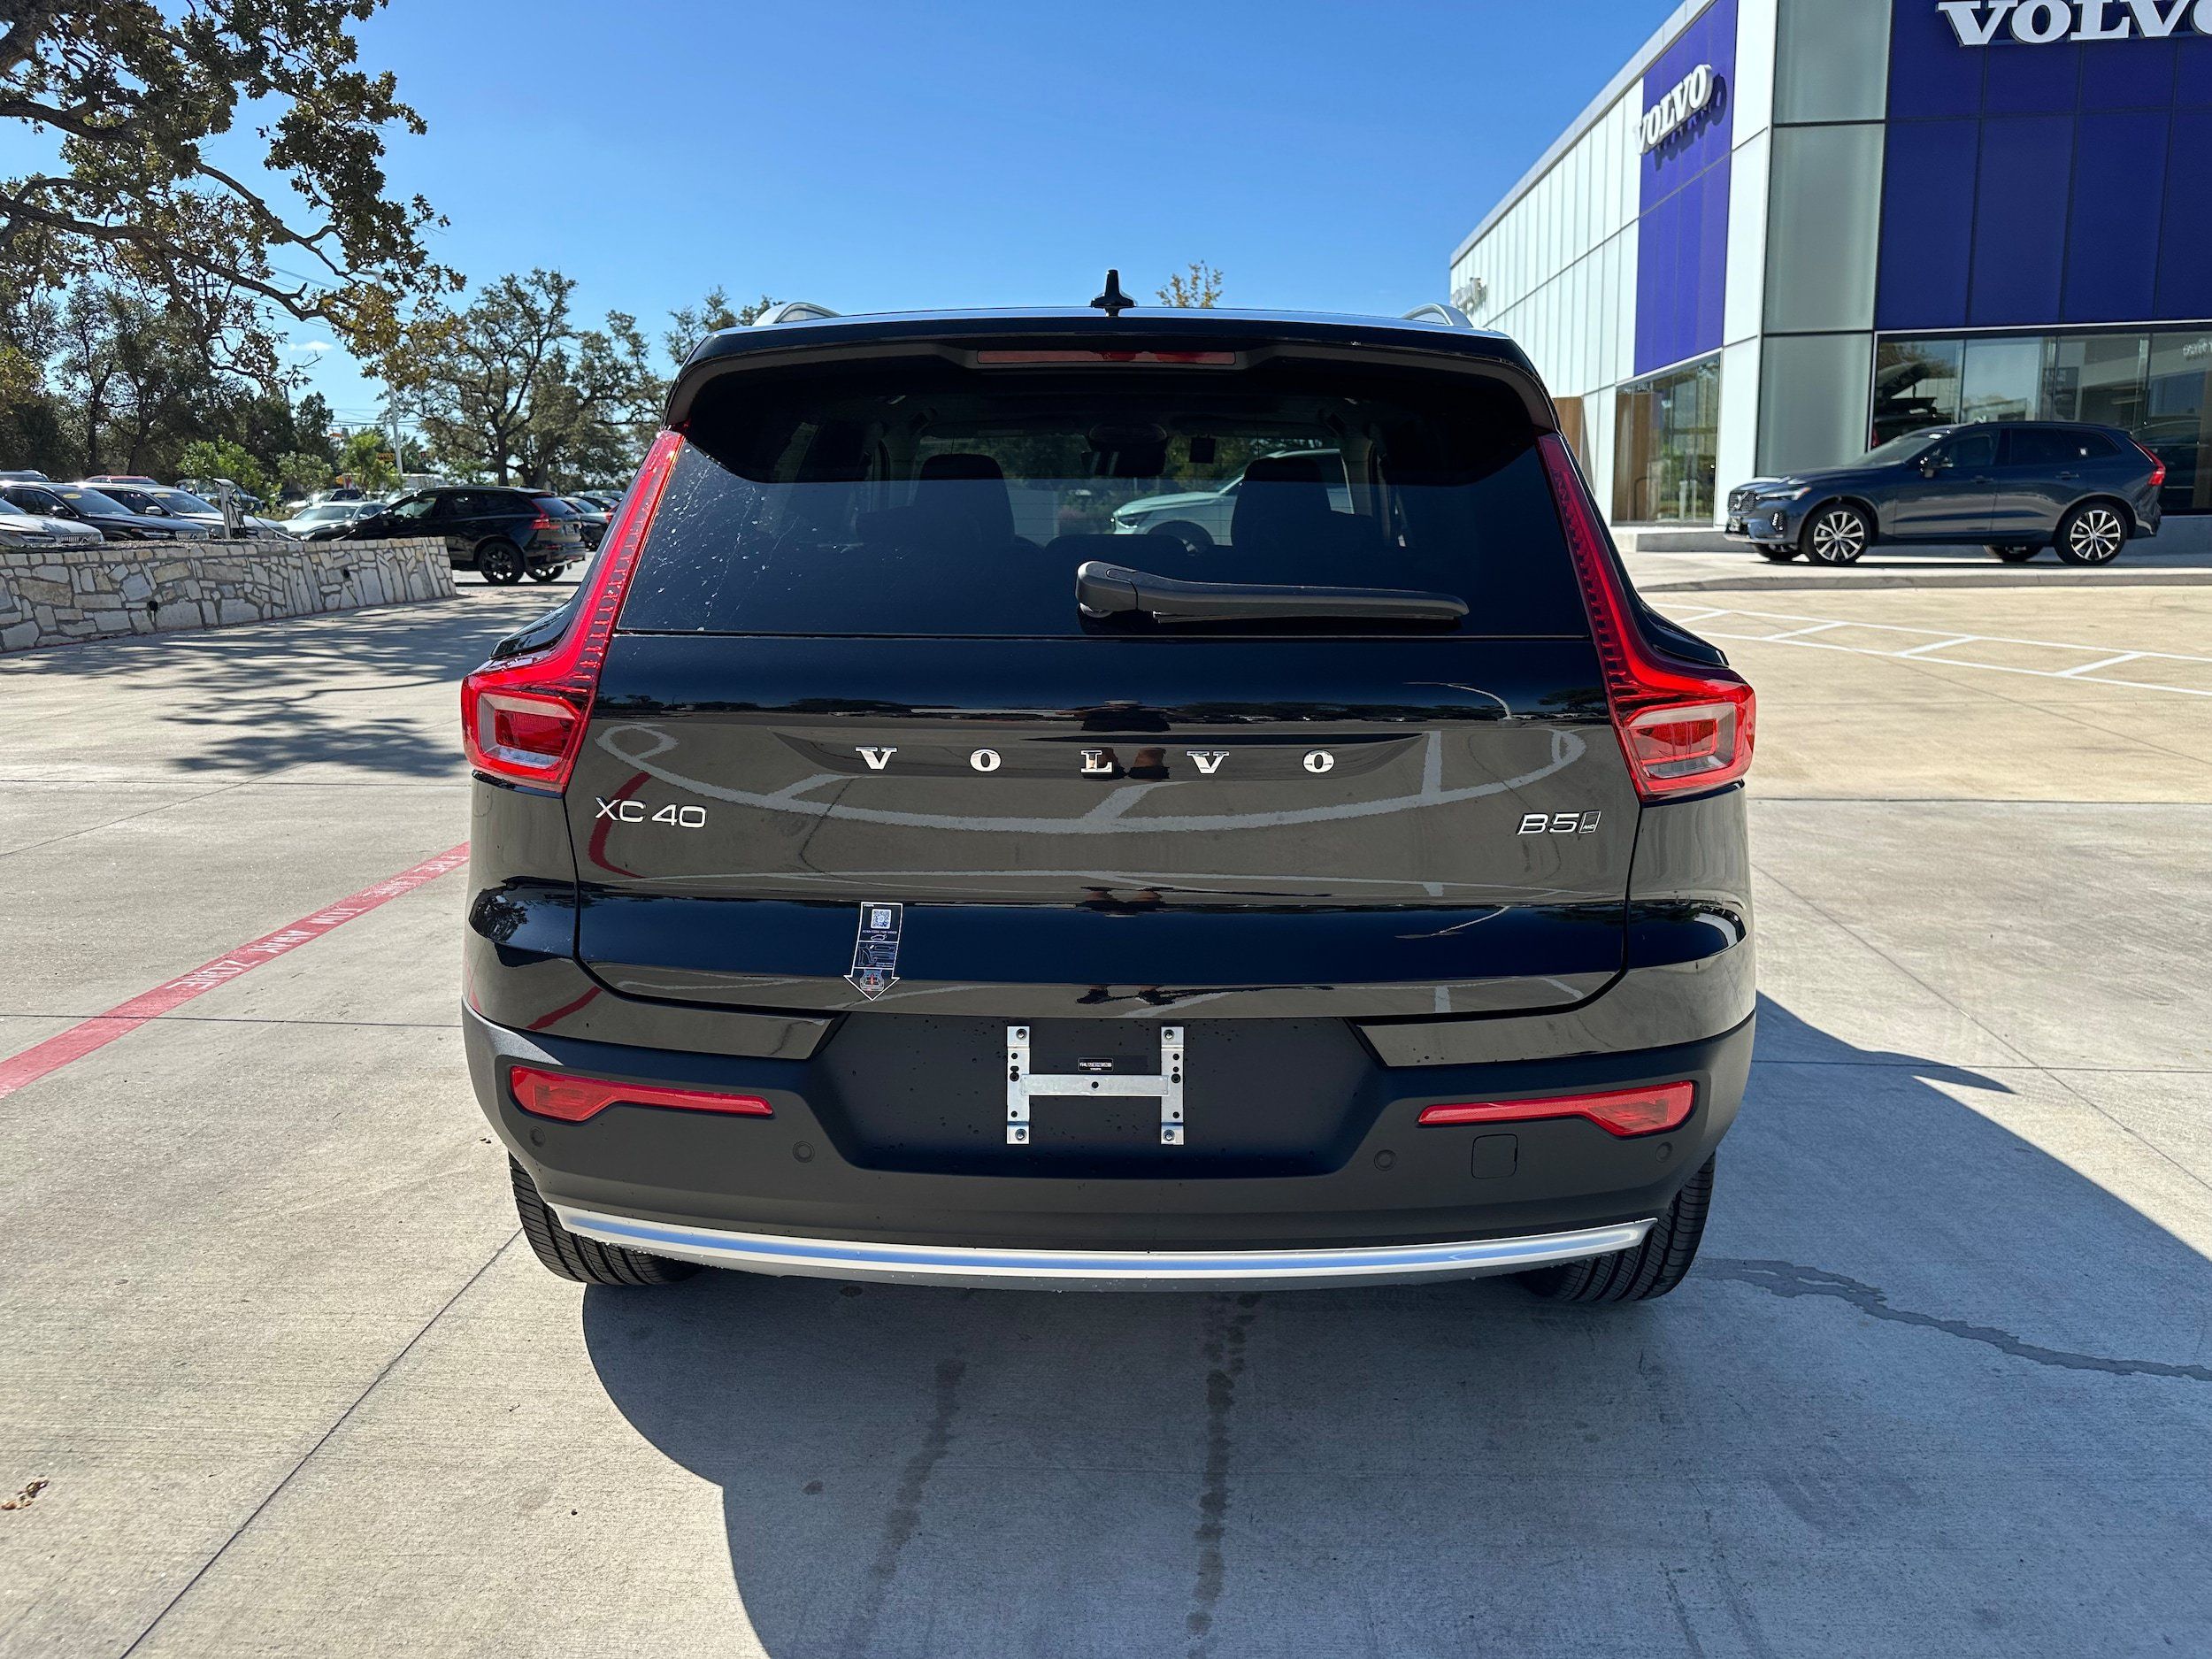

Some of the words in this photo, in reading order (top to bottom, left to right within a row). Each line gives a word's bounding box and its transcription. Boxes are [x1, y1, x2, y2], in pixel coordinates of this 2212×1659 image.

[1633, 64, 1711, 155] VOLVO
[856, 746, 1334, 774] VOLVO
[1517, 813, 1579, 835] B5
[306, 907, 368, 925] TOW
[248, 930, 317, 954] AWAY
[165, 960, 260, 990] ZONE
